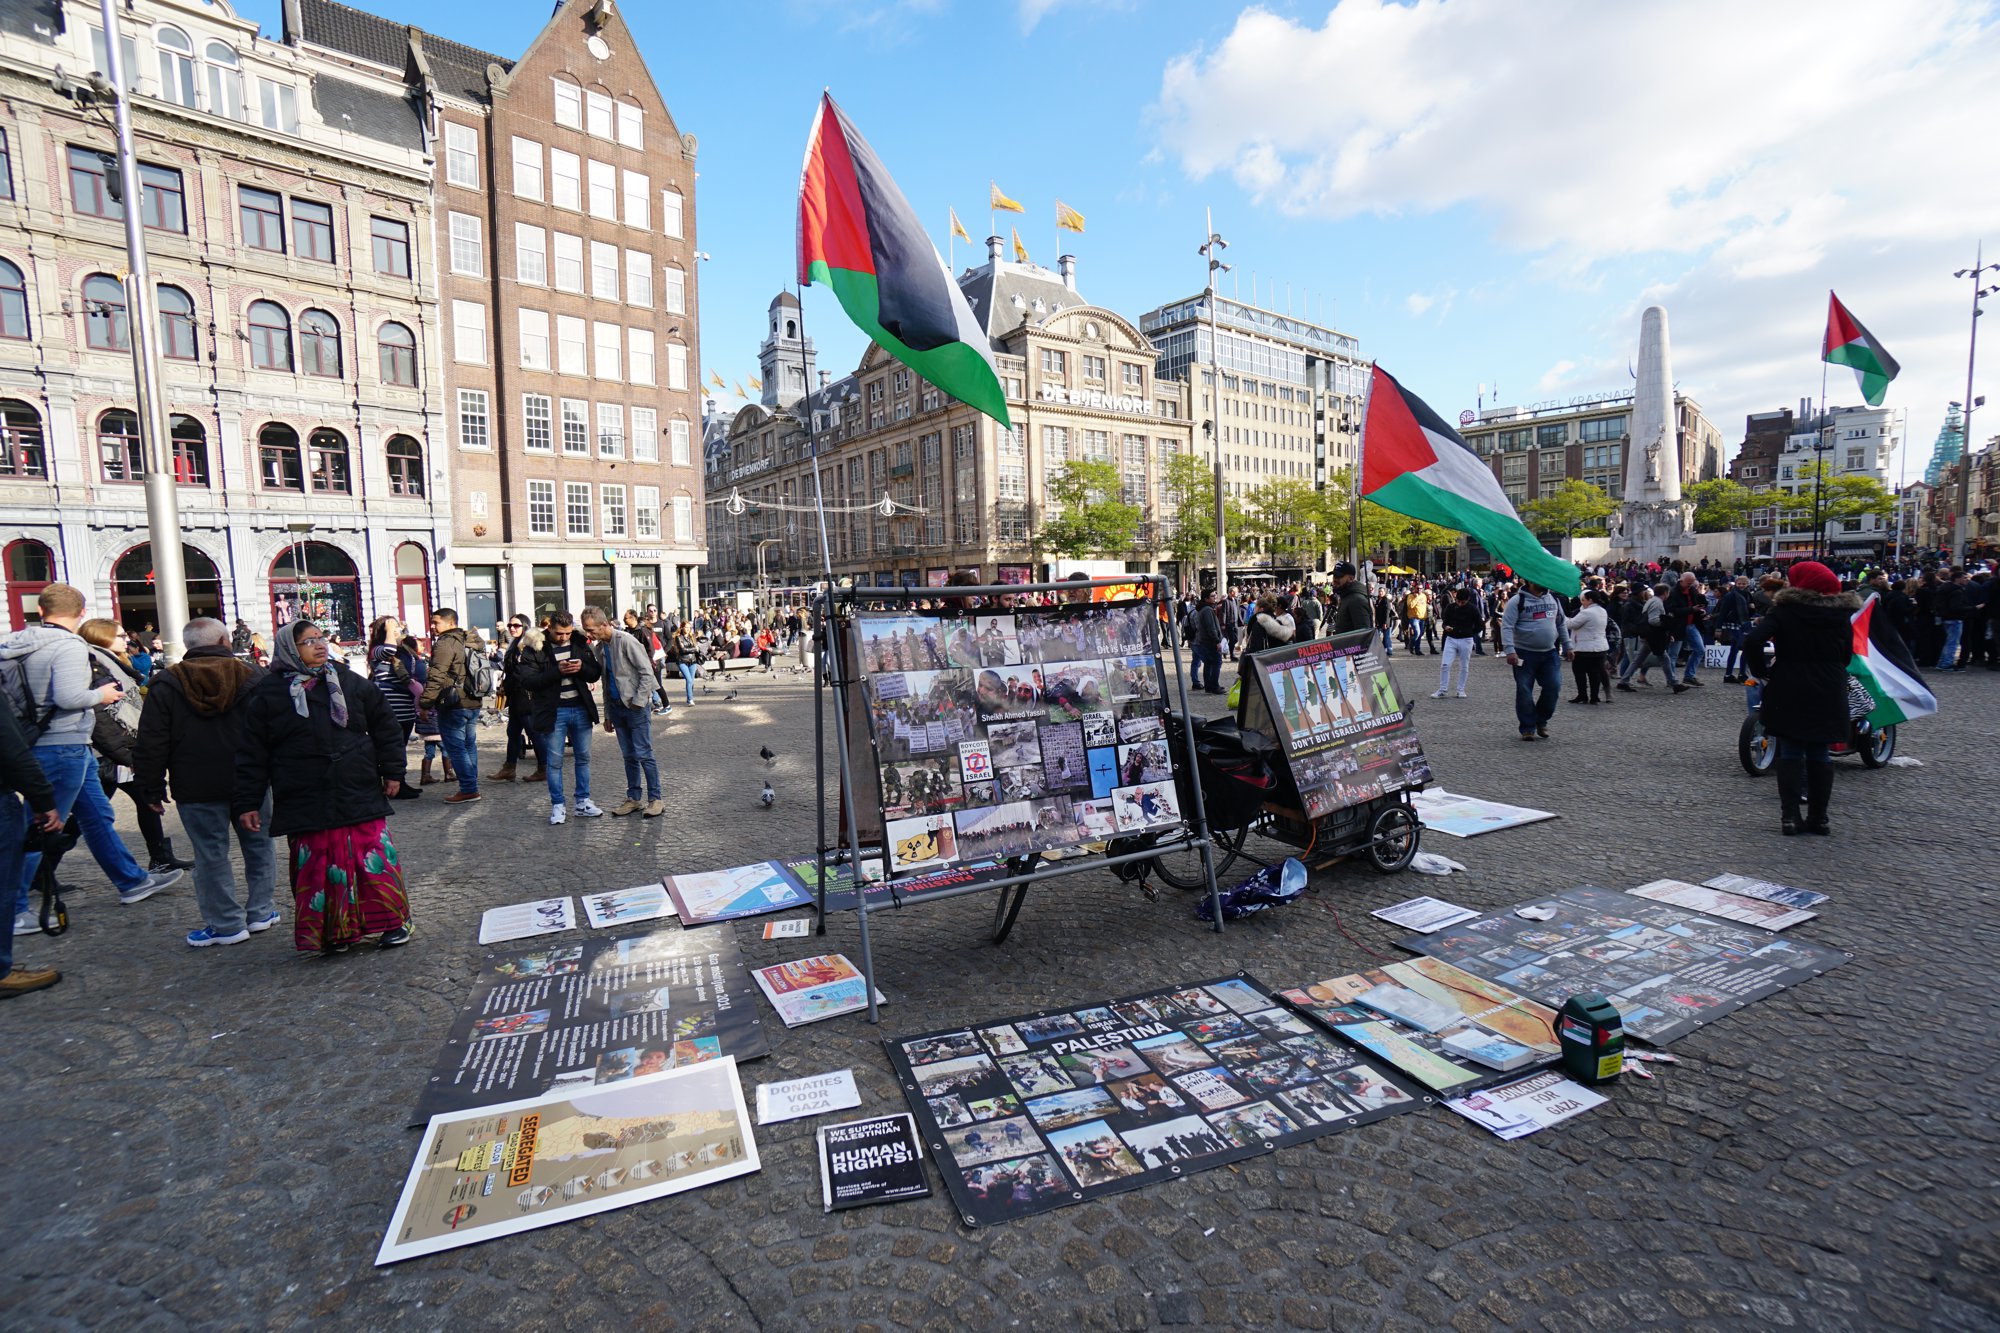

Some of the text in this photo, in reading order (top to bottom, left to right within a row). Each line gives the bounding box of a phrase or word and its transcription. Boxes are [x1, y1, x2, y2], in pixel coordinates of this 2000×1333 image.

[1042, 382, 1153, 414] DE BIJENKORF
[1522, 398, 1562, 412] HOTEL
[1097, 643, 1144, 654] Dit is Israel
[1298, 642, 1333, 657] PALESTINA
[1707, 649, 1725, 658] RIV
[1266, 662, 1286, 673] WIPED
[1286, 660, 1298, 669] OFF
[1298, 657, 1307, 666] THE
[1307, 654, 1320, 664] MAP
[1320, 651, 1334, 661] 1947
[1334, 649, 1345, 657] TILL
[1706, 658, 1721, 667] ER
[981, 709, 1046, 722] Sheikh Ahmed Yassin
[1291, 737, 1314, 750] DON'T
[1315, 732, 1331, 743] BUY
[1332, 724, 1361, 740] ISRAELI
[1362, 712, 1404, 730] APARTHEID
[960, 741, 988, 750] BOYCOTT
[965, 772, 992, 780] ISRAEL
[904, 874, 975, 892] PALESTINA
[707, 964, 728, 995] misdrijven
[715, 993, 731, 1010] 2014
[1087, 1018, 1120, 1031] ISRAEL
[1101, 1023, 1113, 1032] IN
[1051, 1021, 1173, 1055] PALESTINA
[1183, 1075, 1216, 1089] JEWISH
[1187, 1071, 1205, 1081] AM
[770, 1076, 843, 1096] DONATIES
[1199, 1085, 1230, 1098] ISRAEL
[1494, 1072, 1561, 1101] DONATIONS
[786, 1089, 829, 1104] VOOR
[1530, 1090, 1561, 1105] FOR
[789, 1099, 831, 1114] GAZA
[1545, 1098, 1584, 1116] GAZA
[830, 1120, 894, 1138] WE SUPPORT
[830, 1125, 901, 1143] PALESTINIAN
[471, 1143, 486, 1170] DICTATES
[490, 1143, 502, 1163] COLOR
[504, 1132, 519, 1168] ROAD SYSTEM
[511, 1114, 539, 1183] SEGREGATED
[831, 1141, 907, 1164] HUMAN
[833, 1150, 914, 1175] RIGHTS!
